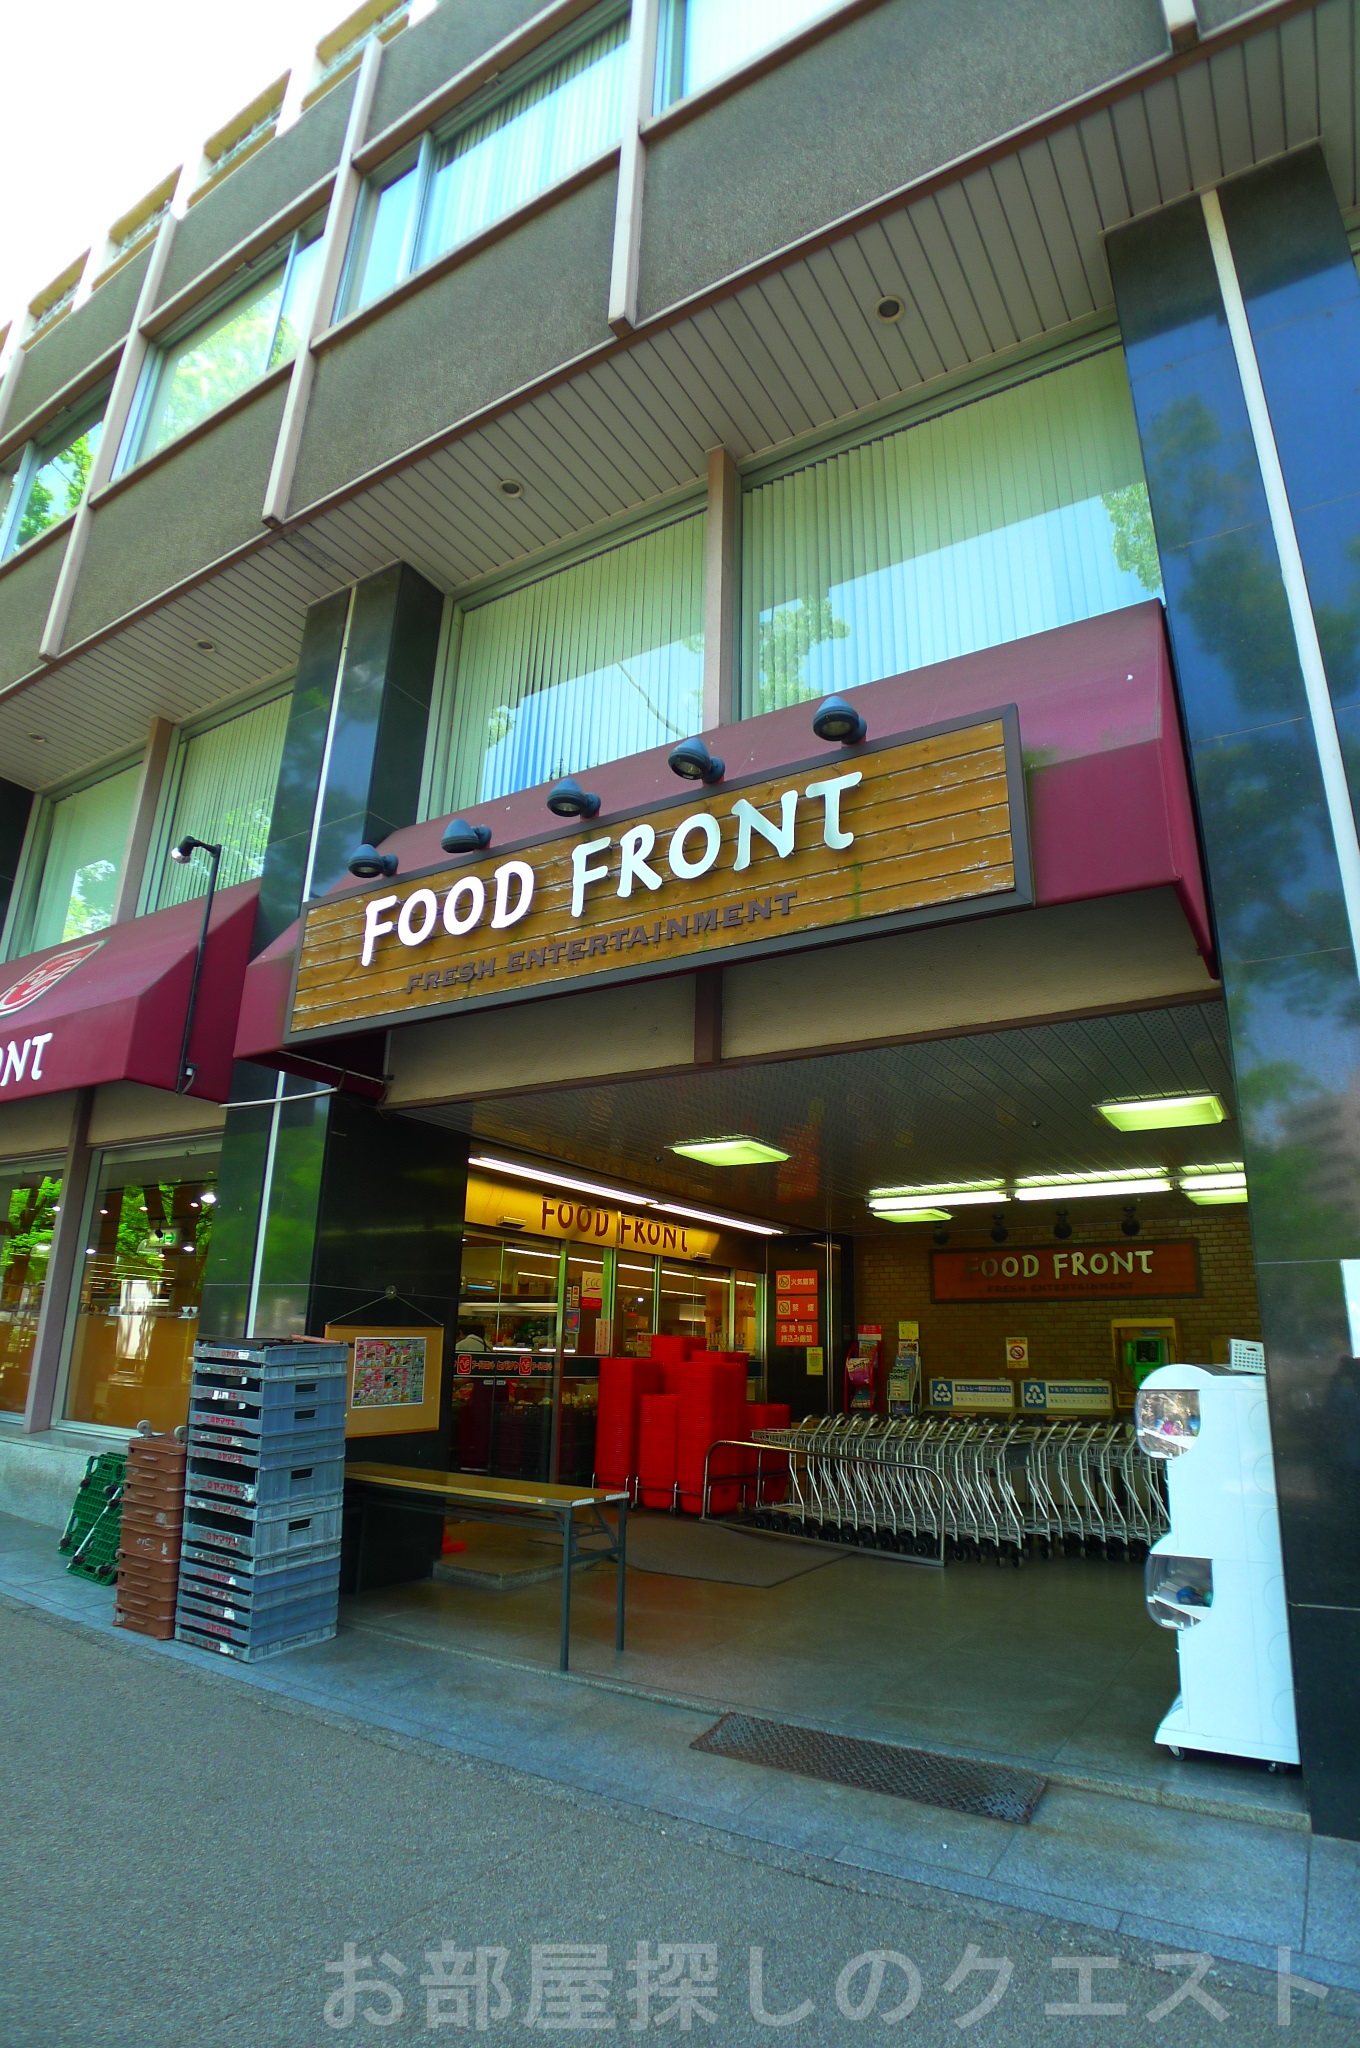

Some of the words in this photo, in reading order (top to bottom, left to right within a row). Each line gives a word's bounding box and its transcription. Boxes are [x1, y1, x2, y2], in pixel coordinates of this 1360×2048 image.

[361, 860, 535, 967] FOOD
[571, 771, 863, 918] FRONT
[405, 957, 497, 994] FRESH
[506, 890, 797, 974] ENTERTAINMENT
[0, 1032, 54, 1087] NT
[541, 1193, 609, 1237] FOOD
[620, 1211, 690, 1253] FRONT
[965, 1254, 1040, 1282] FOOD
[1053, 1250, 1154, 1280] FRONT
